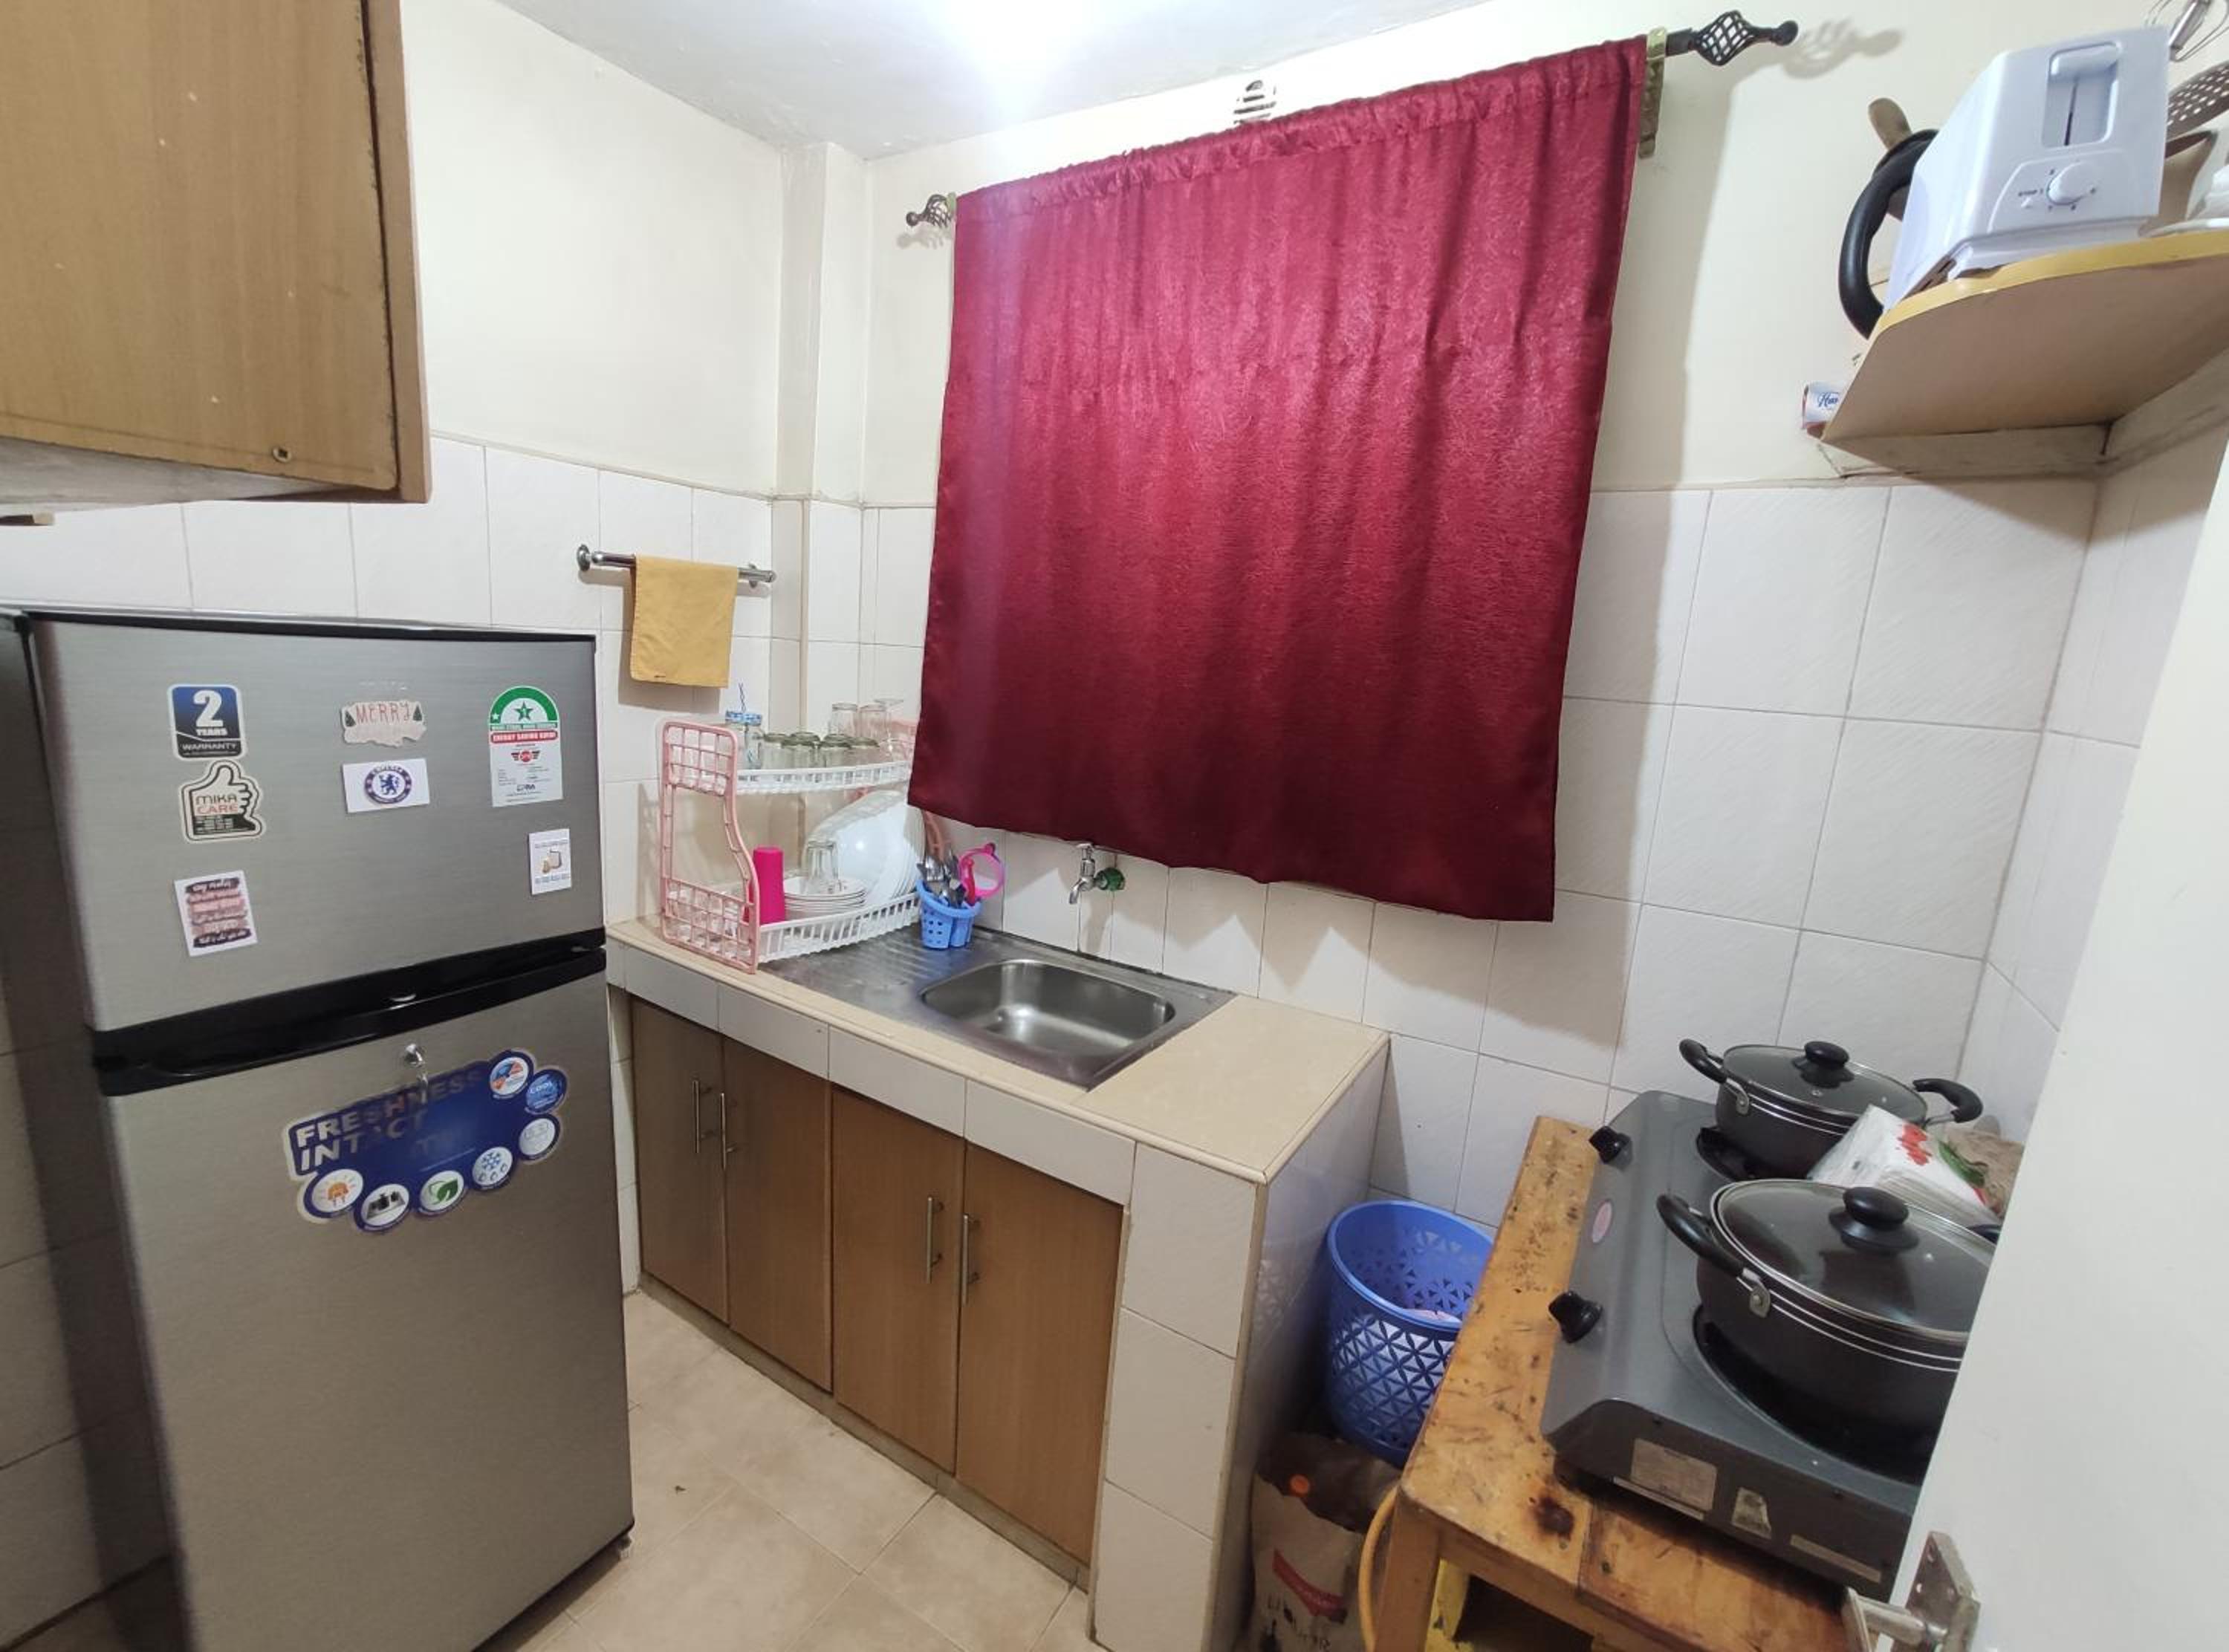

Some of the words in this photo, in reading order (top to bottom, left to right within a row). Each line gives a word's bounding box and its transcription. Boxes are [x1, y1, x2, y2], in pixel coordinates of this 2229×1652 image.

[193, 689, 224, 727] 2
[356, 703, 410, 723] MERRY
[196, 728, 228, 736] YEARS
[195, 793, 238, 805] MIKA
[197, 803, 239, 815] CARE
[301, 1108, 429, 1171] INTCT
